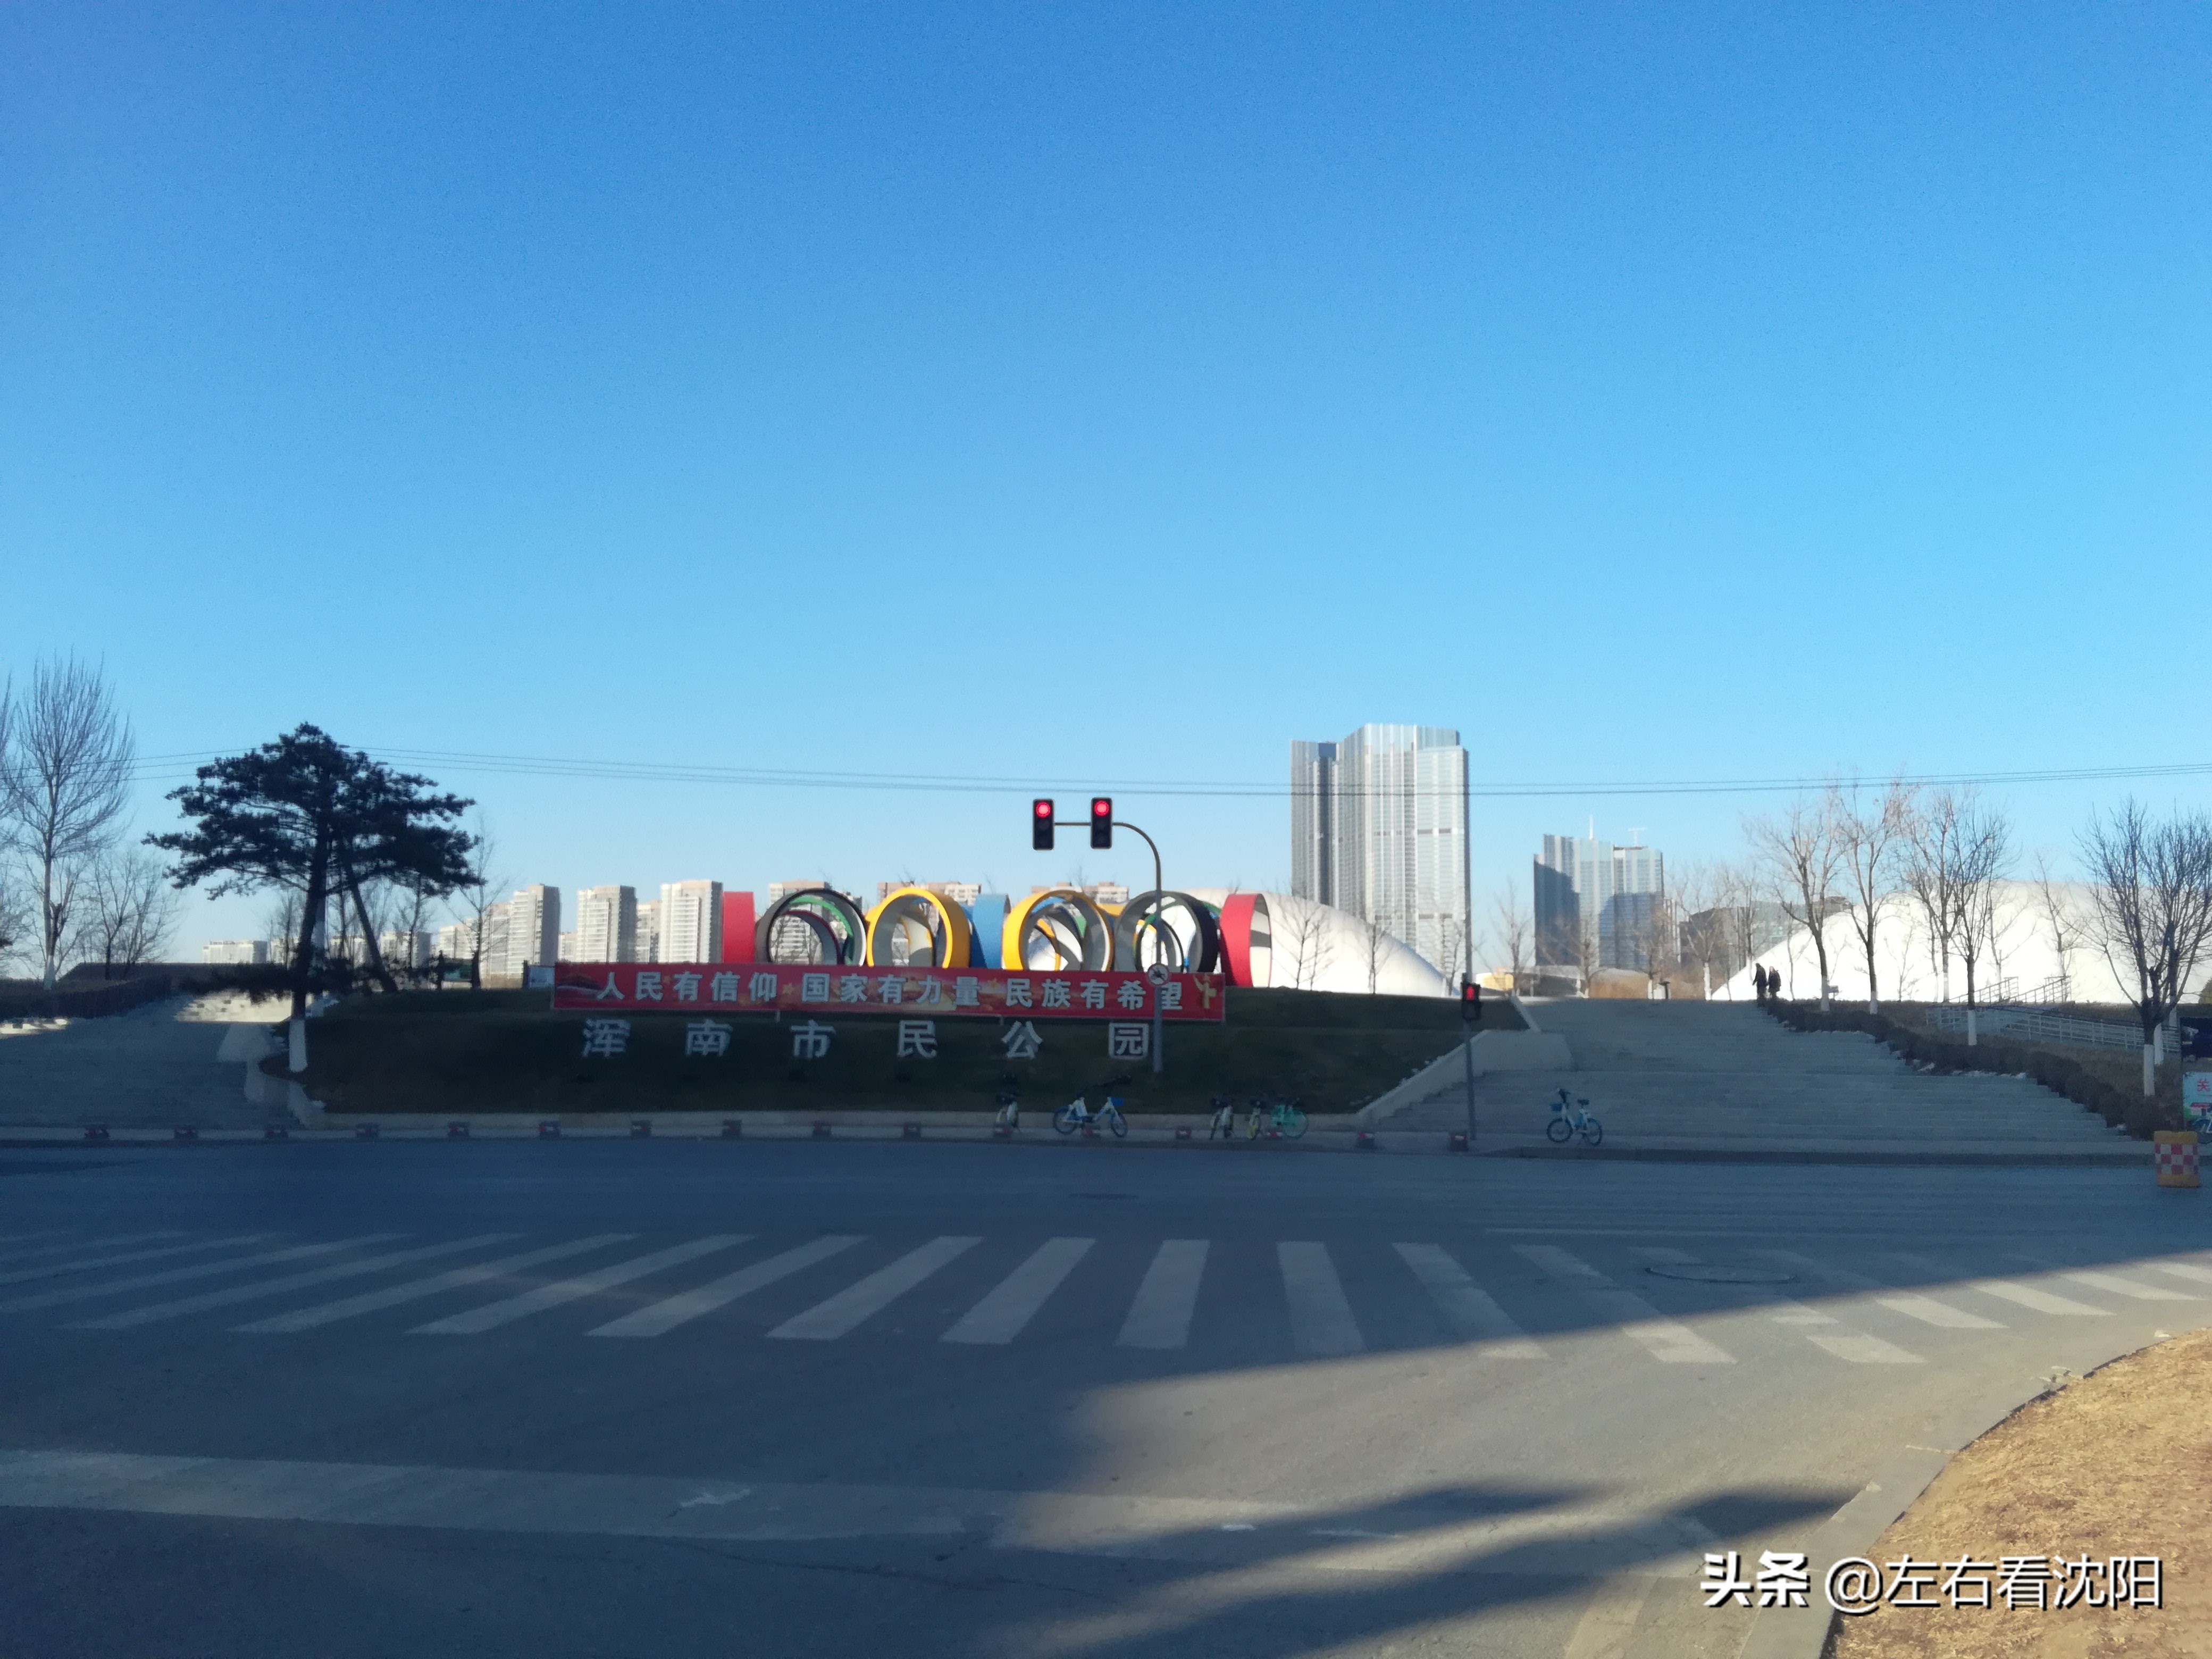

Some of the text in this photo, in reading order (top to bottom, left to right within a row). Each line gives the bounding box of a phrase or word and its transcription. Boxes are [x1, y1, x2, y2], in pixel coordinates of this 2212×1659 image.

[596, 971, 778, 1002] 人民有信仰
[801, 973, 981, 1007] 国家有力量
[581, 1018, 1150, 1060] 浑南市民公园
